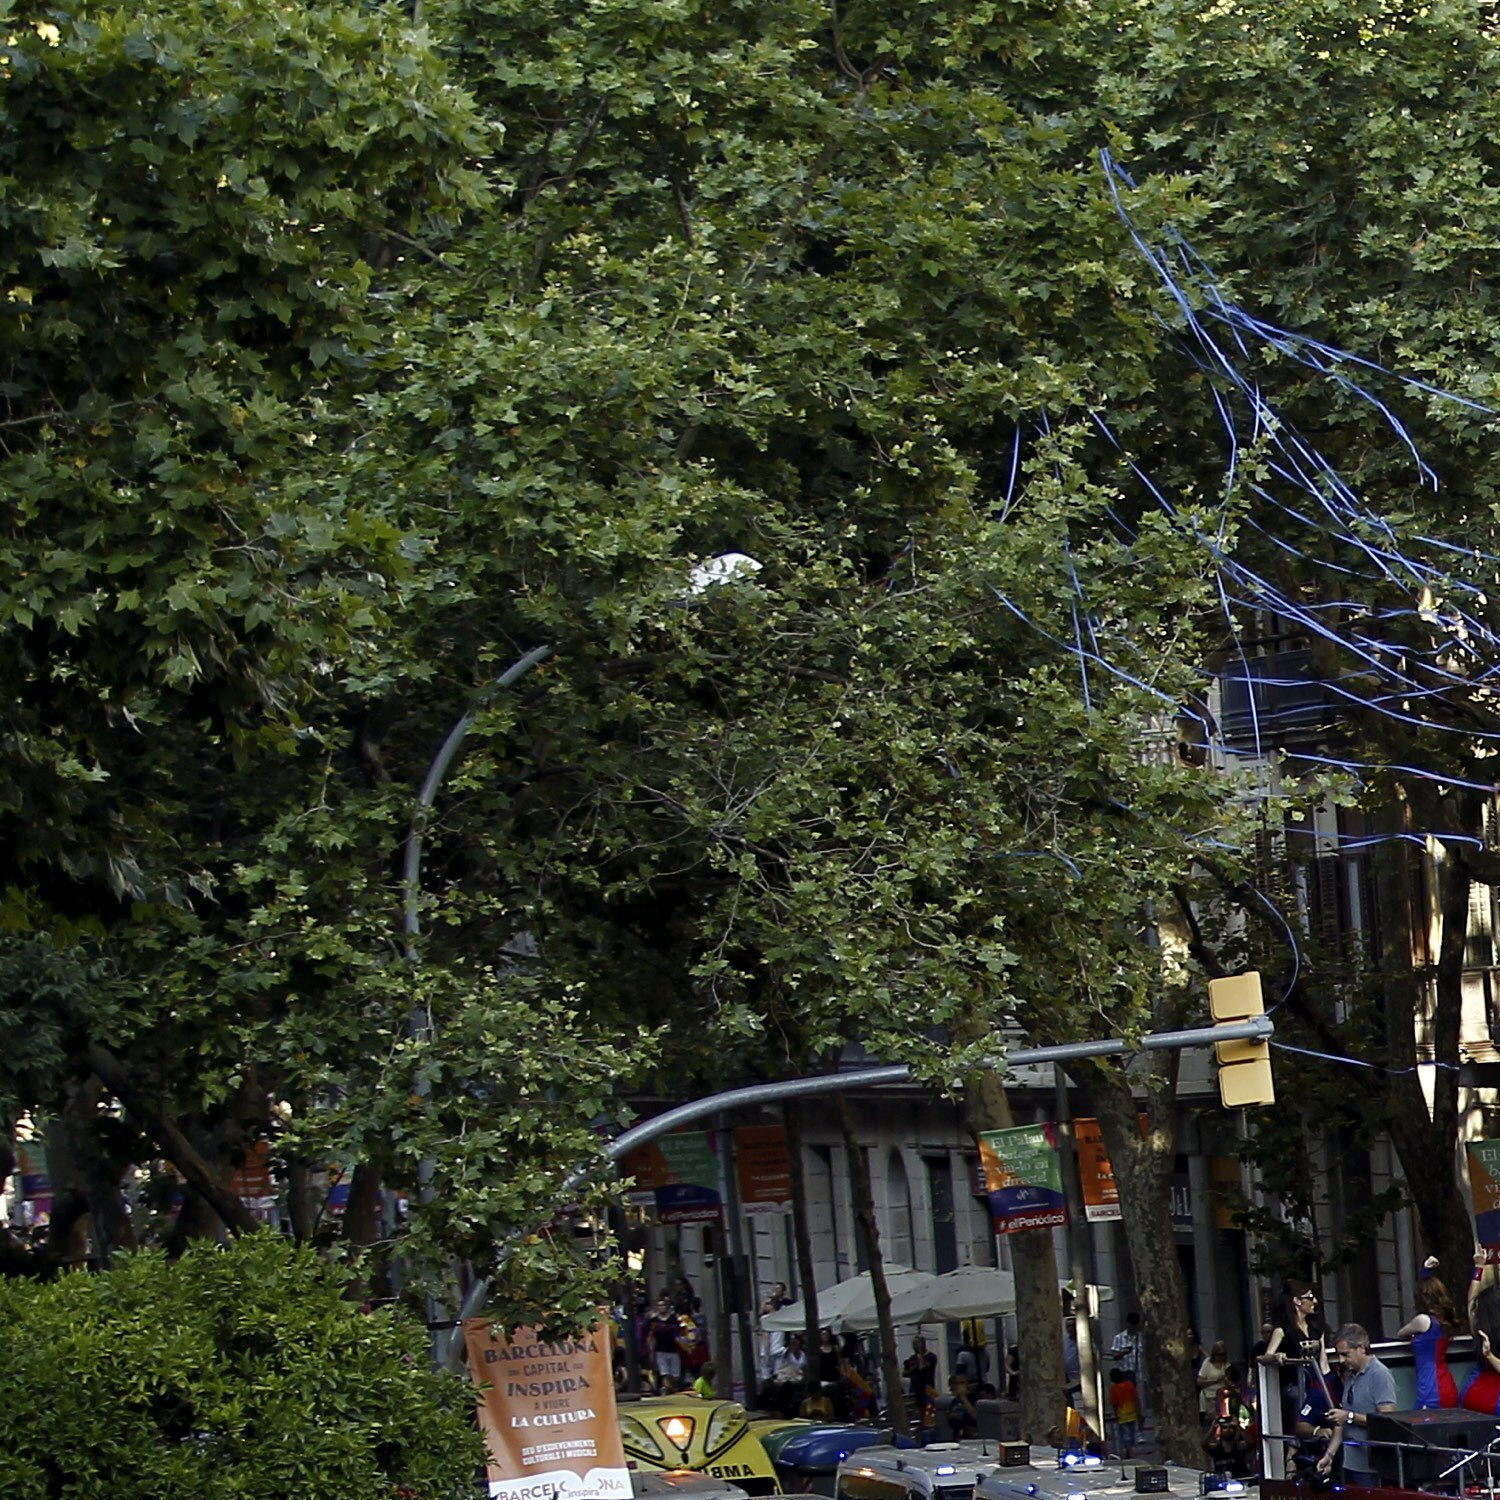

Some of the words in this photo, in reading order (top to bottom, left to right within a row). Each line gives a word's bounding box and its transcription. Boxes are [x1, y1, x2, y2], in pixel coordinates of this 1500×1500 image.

[1481, 1149, 1498, 1162] El
[484, 1339, 600, 1364] BARCELONA
[523, 1361, 571, 1376] CAPITAL
[508, 1375, 590, 1397] INSPIRA
[511, 1416, 528, 1428] LA
[533, 1408, 597, 1427] CULTURA
